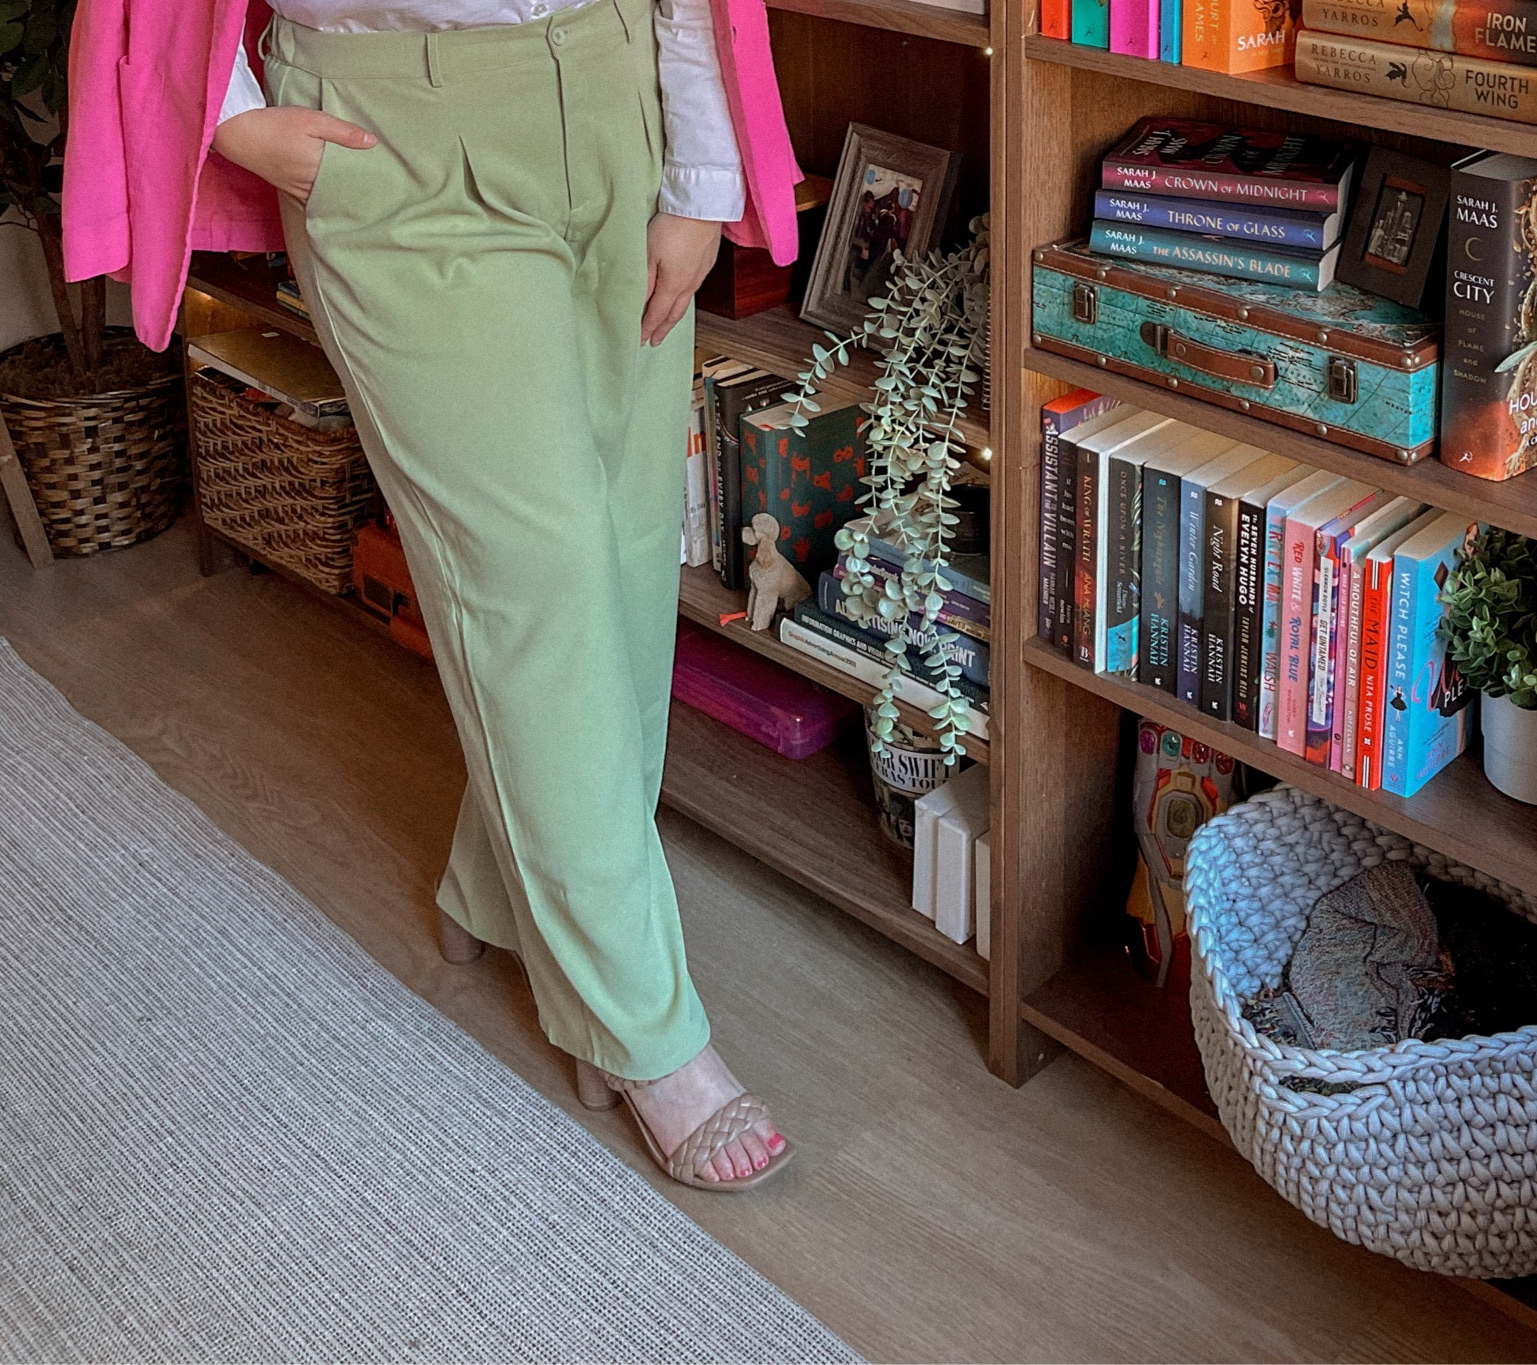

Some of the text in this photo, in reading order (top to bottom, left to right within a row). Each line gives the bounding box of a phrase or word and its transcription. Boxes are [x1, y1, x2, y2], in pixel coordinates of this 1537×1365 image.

[1322, 9, 1379, 27] YARROS
[1486, 12, 1526, 33] IRON
[1237, 30, 1286, 51] SARAH
[1311, 43, 1377, 65] REBECCA
[1474, 28, 1536, 53] FLAME
[1315, 64, 1371, 83] YARROS
[1465, 69, 1529, 94] FOURTH
[1475, 87, 1519, 109] WING
[1117, 166, 1158, 180] SARAH J.
[1124, 178, 1151, 189] MAAS
[1164, 175, 1218, 193] CROWN
[1236, 184, 1308, 202] MIDNIGHT
[1109, 198, 1150, 212] SARAH J.
[1116, 210, 1143, 221] MAAS
[1456, 194, 1499, 213] SARAH J.
[1167, 210, 1223, 230] THRONE
[1243, 221, 1286, 238] GLASS
[1456, 207, 1498, 229] MAAS
[1105, 230, 1145, 245] SARAH J.
[1110, 243, 1137, 255] MAAS
[1152, 245, 1291, 278] THE ASSASSIN'S BLADE
[1454, 270, 1495, 287] CRESCENT
[1453, 281, 1495, 305] CITY
[1459, 309, 1486, 321] HOUSE
[1458, 339, 1484, 353] FLAME
[1453, 369, 1487, 383] SHADOW
[1120, 471, 1128, 500] ONCE
[1083, 475, 1092, 562] KING WRATH
[1043, 512, 1057, 568] VILLAIN
[1188, 511, 1199, 591] Winter Garden
[1250, 524, 1258, 555] SEVEN
[1292, 541, 1304, 564] RED
[1119, 546, 1127, 574] RIVER
[1210, 525, 1224, 593] Night Road
[1238, 513, 1250, 605] EVELYN HUGO
[1083, 572, 1092, 594] ANA
[1248, 557, 1257, 606] HUSBANDS
[1291, 567, 1303, 601] WHITE
[1150, 613, 1159, 665] HANNAH
[1289, 616, 1301, 650] ROYAL
[1320, 619, 1328, 633] GET
[1348, 571, 1360, 687] A MOUTHFUL OF AIR
[1395, 573, 1411, 680] WITCH PLEASE
[1160, 617, 1168, 667] KRISTIN
[1183, 624, 1191, 673] HANNAH
[1190, 628, 1198, 674] KRISTIN
[1318, 633, 1327, 672] UNTAMED
[1364, 619, 1380, 670] MAID
[1208, 633, 1216, 683] HANNAH
[1215, 637, 1224, 685] KRISTIN
[1239, 616, 1250, 699] TAYLOR JENKINS REID
[1288, 654, 1299, 682] BLUE
[1264, 652, 1277, 692] WALSH
[1364, 675, 1374, 733] NITA PROSE
[1387, 724, 1396, 768] AGUIRRE
